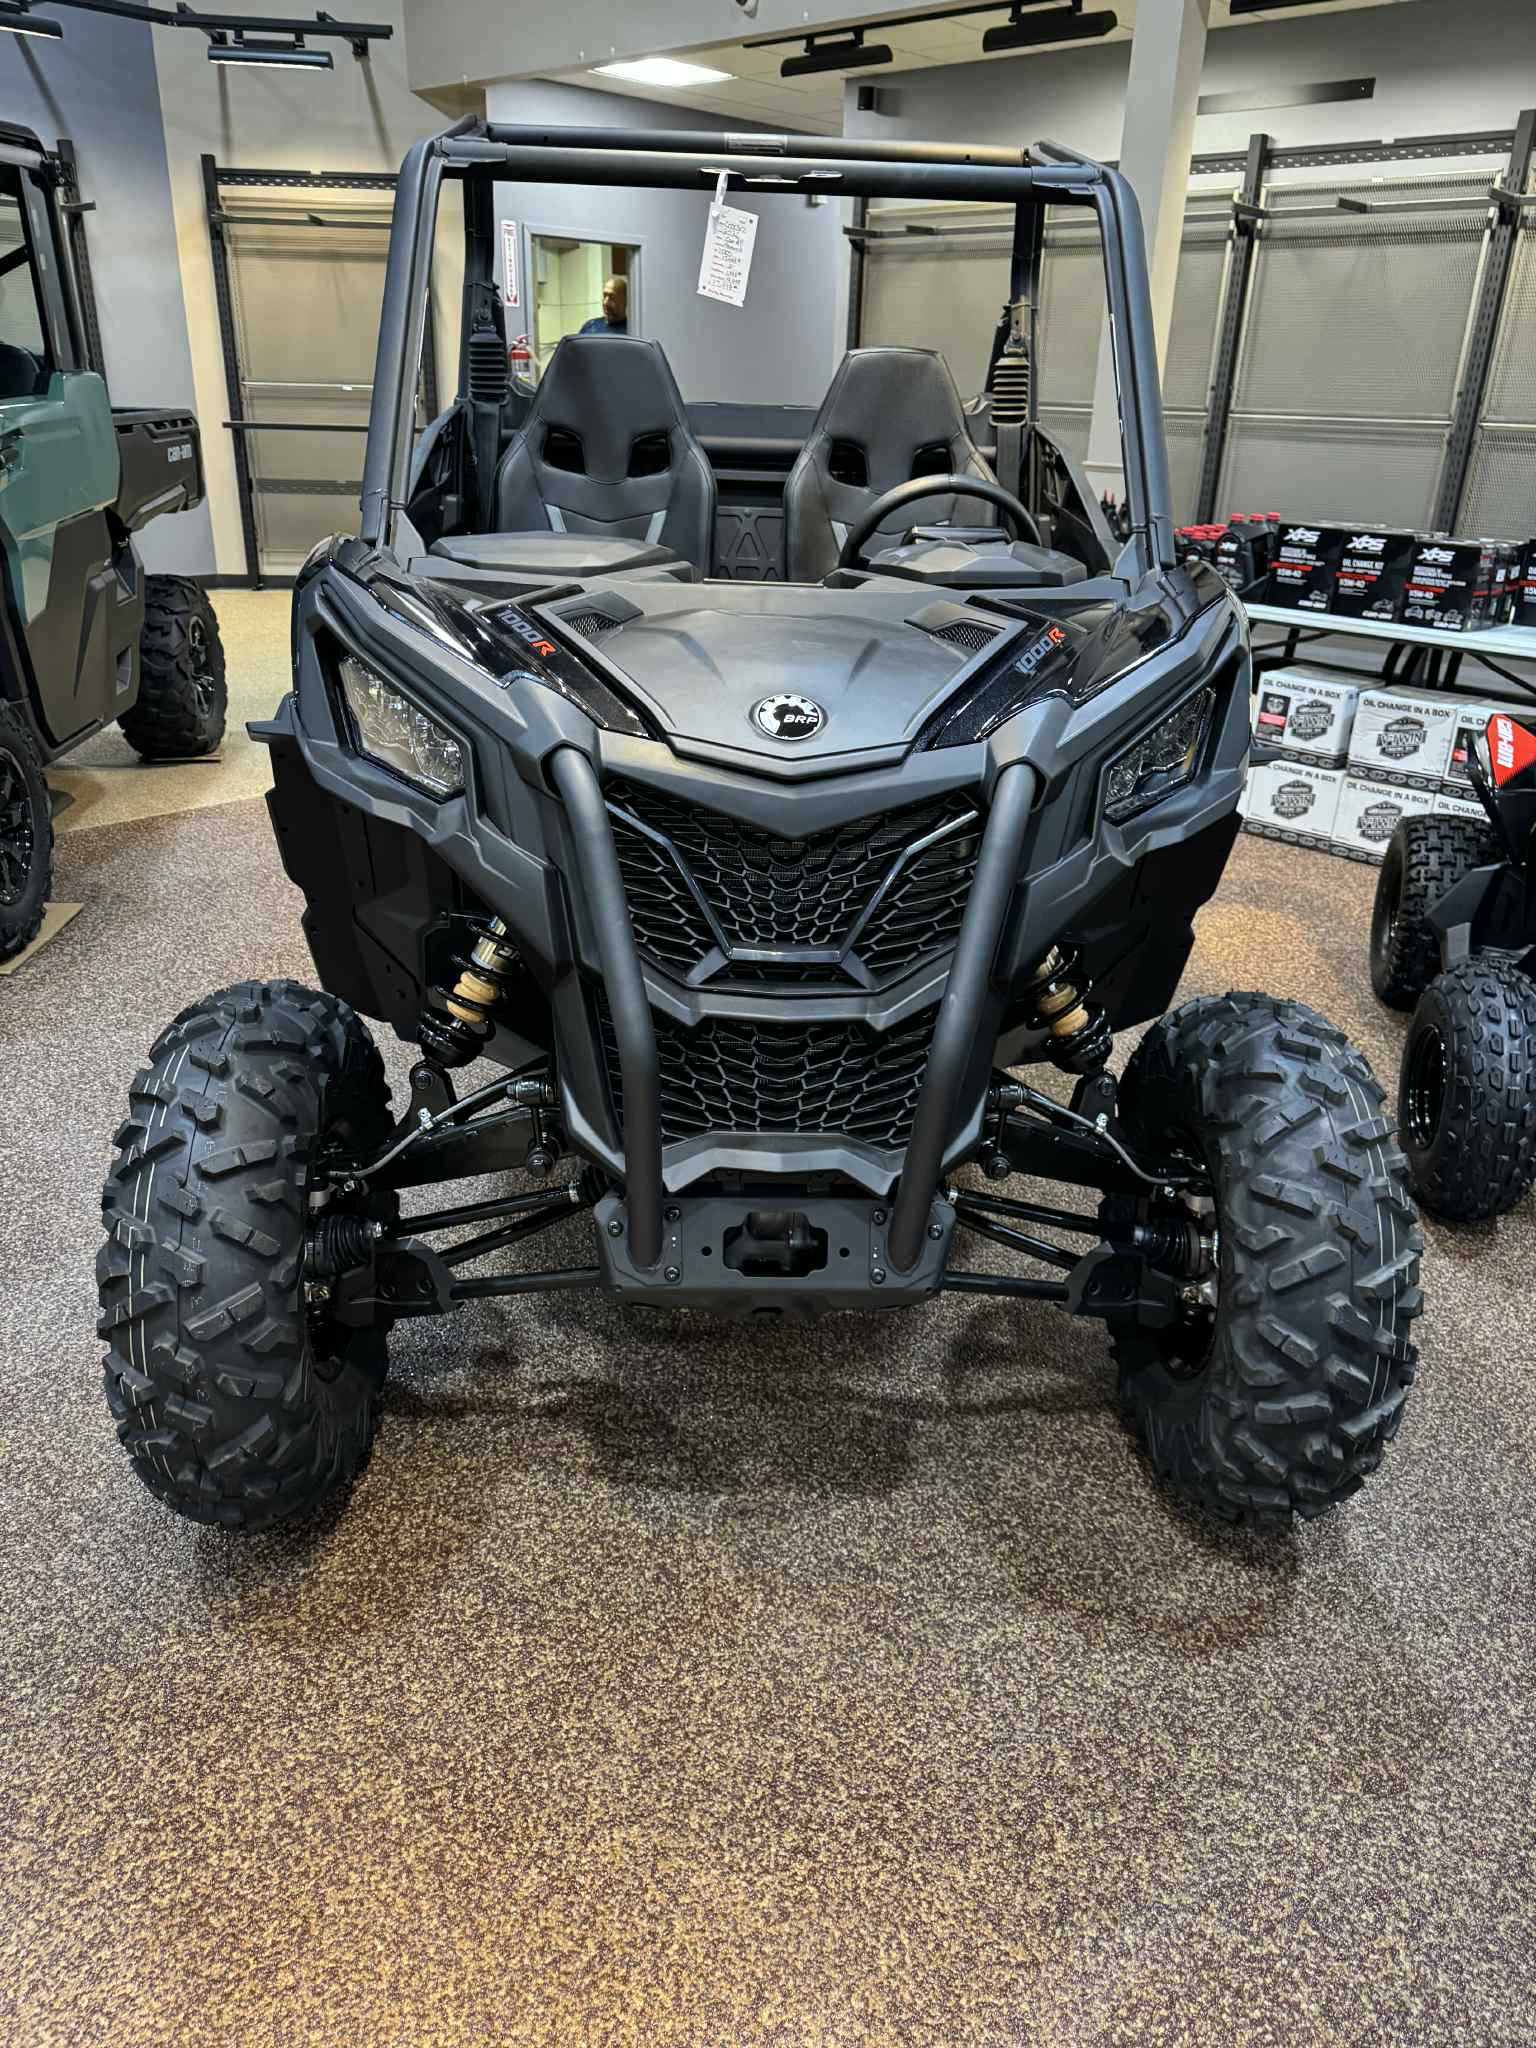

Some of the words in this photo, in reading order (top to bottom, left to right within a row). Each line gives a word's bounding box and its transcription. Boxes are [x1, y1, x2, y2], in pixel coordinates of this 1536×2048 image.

[1284, 528, 1321, 543] XPS
[1346, 535, 1387, 551] XPS
[1416, 547, 1456, 561] XPS
[497, 609, 557, 656] 1000R
[1015, 627, 1066, 674] 1000R
[1263, 679, 1274, 687] OIL
[1275, 680, 1306, 692] CHANGE
[1325, 690, 1341, 699] BOX
[1363, 699, 1376, 708] OIL
[1377, 701, 1412, 714] CHANGE
[1413, 705, 1424, 714] IN
[1432, 708, 1451, 718] BOX
[783, 713, 818, 724] BRP
[1461, 715, 1475, 725] OIL
[1346, 781, 1358, 790] OIL
[1359, 783, 1392, 797] CHANGE
[1394, 791, 1403, 800] IN
[1411, 794, 1429, 805] BOX
[1438, 801, 1450, 811] OIL
